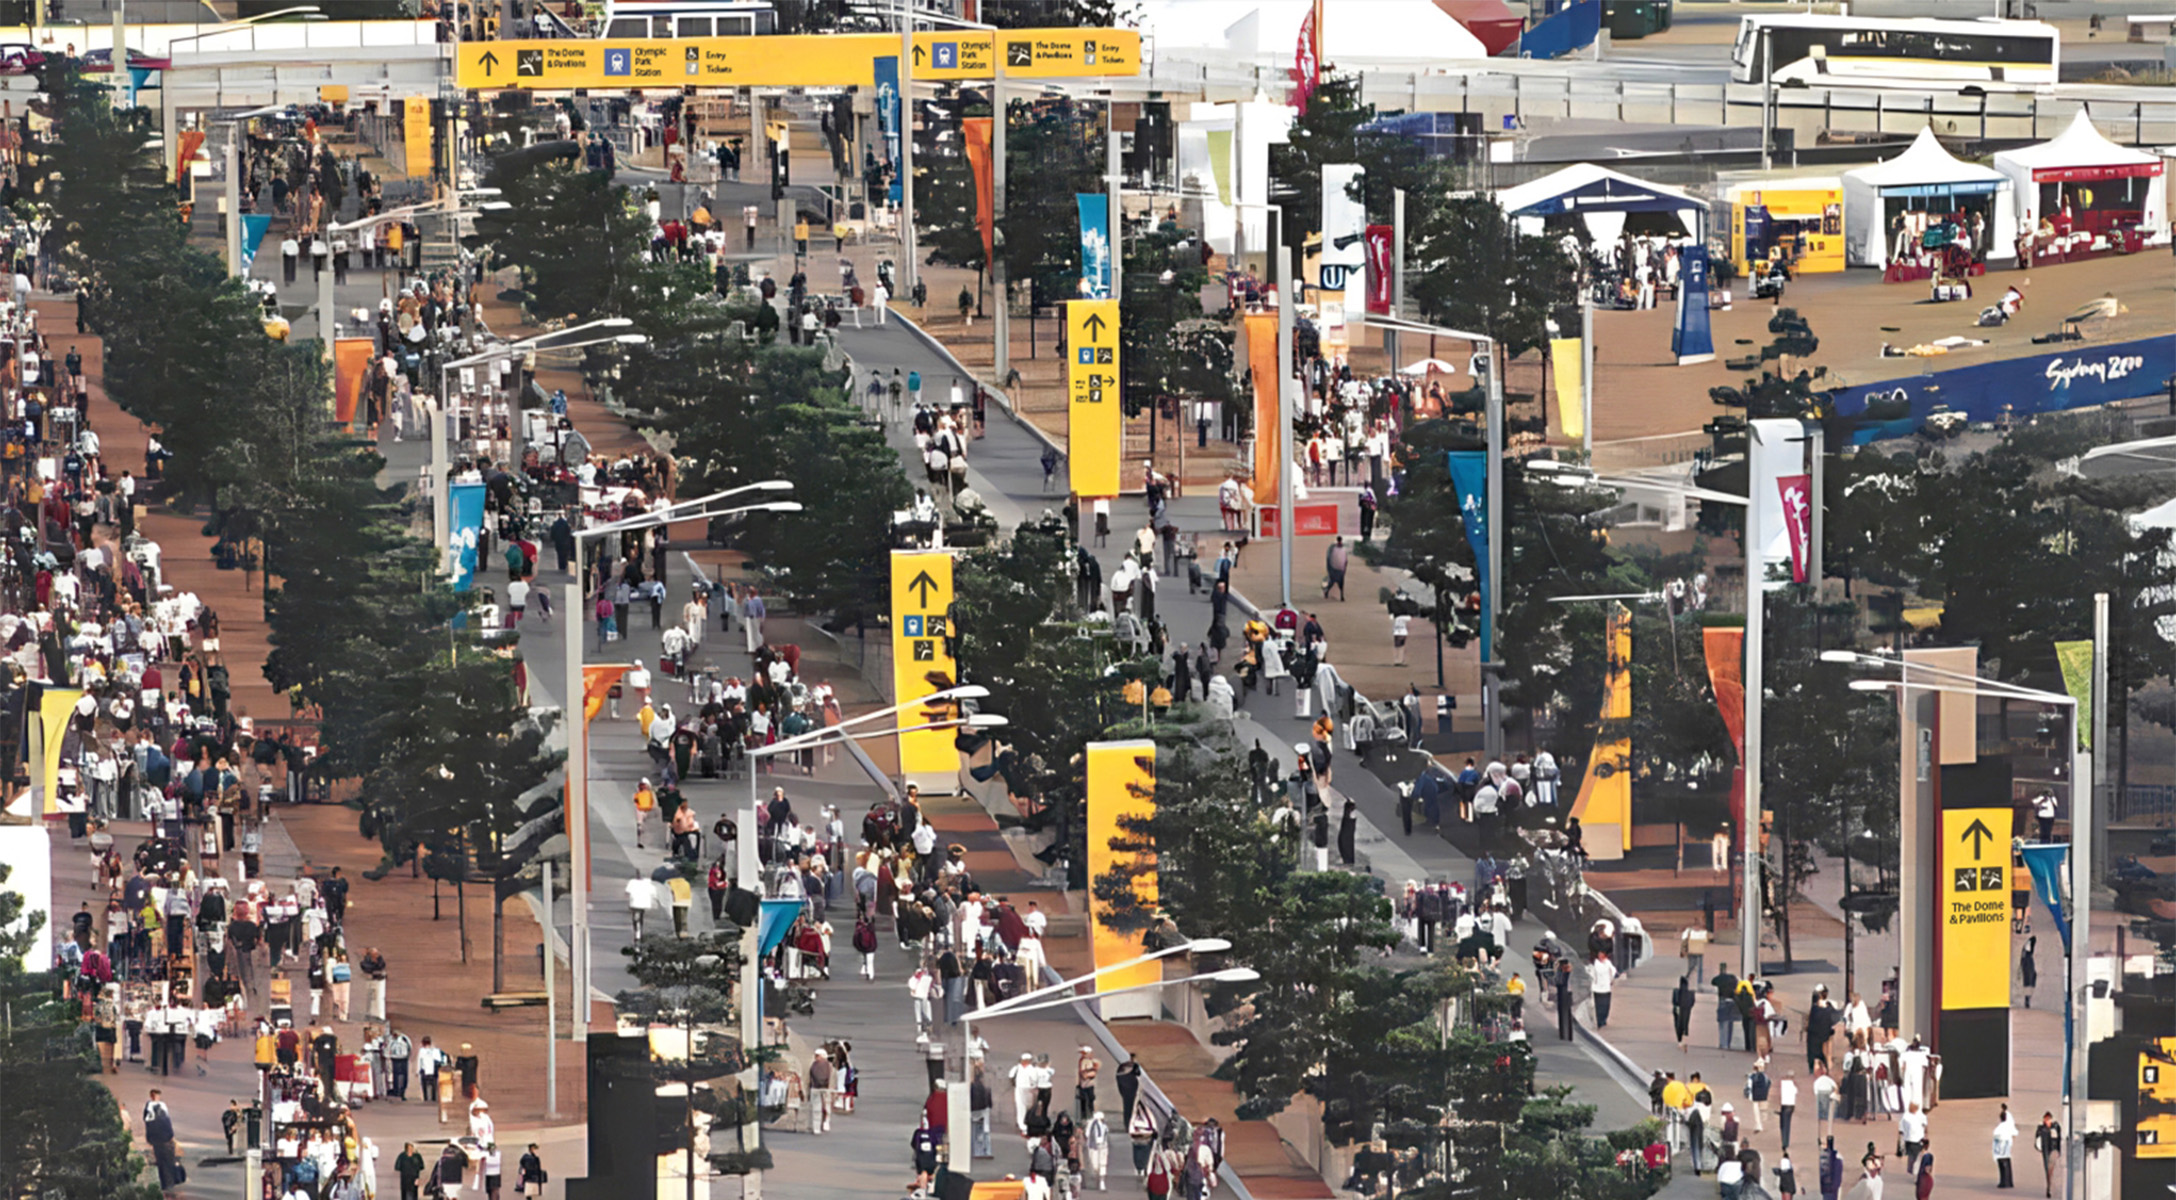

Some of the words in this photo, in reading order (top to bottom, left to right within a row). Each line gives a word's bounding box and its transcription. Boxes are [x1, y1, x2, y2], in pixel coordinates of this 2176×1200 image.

[962, 41, 993, 51] Olympic
[1036, 41, 1049, 49] The
[1051, 42, 1072, 50] Dome
[1102, 44, 1120, 53] Entry
[548, 49, 561, 57] The
[562, 48, 585, 58] Dome
[634, 47, 667, 58] Olympic
[706, 51, 727, 61] Entry
[962, 51, 977, 59] Park
[554, 60, 587, 68] Pavilions
[634, 58, 652, 66] Park
[1102, 56, 1125, 64] Tickets
[706, 64, 733, 74] Tickets
[962, 61, 987, 70] Station
[634, 68, 662, 77] Station
[1951, 902, 1972, 913] The
[1974, 900, 2005, 912] Dome
[1949, 914, 1958, 925] &
[1959, 912, 2005, 925] Pavilions
